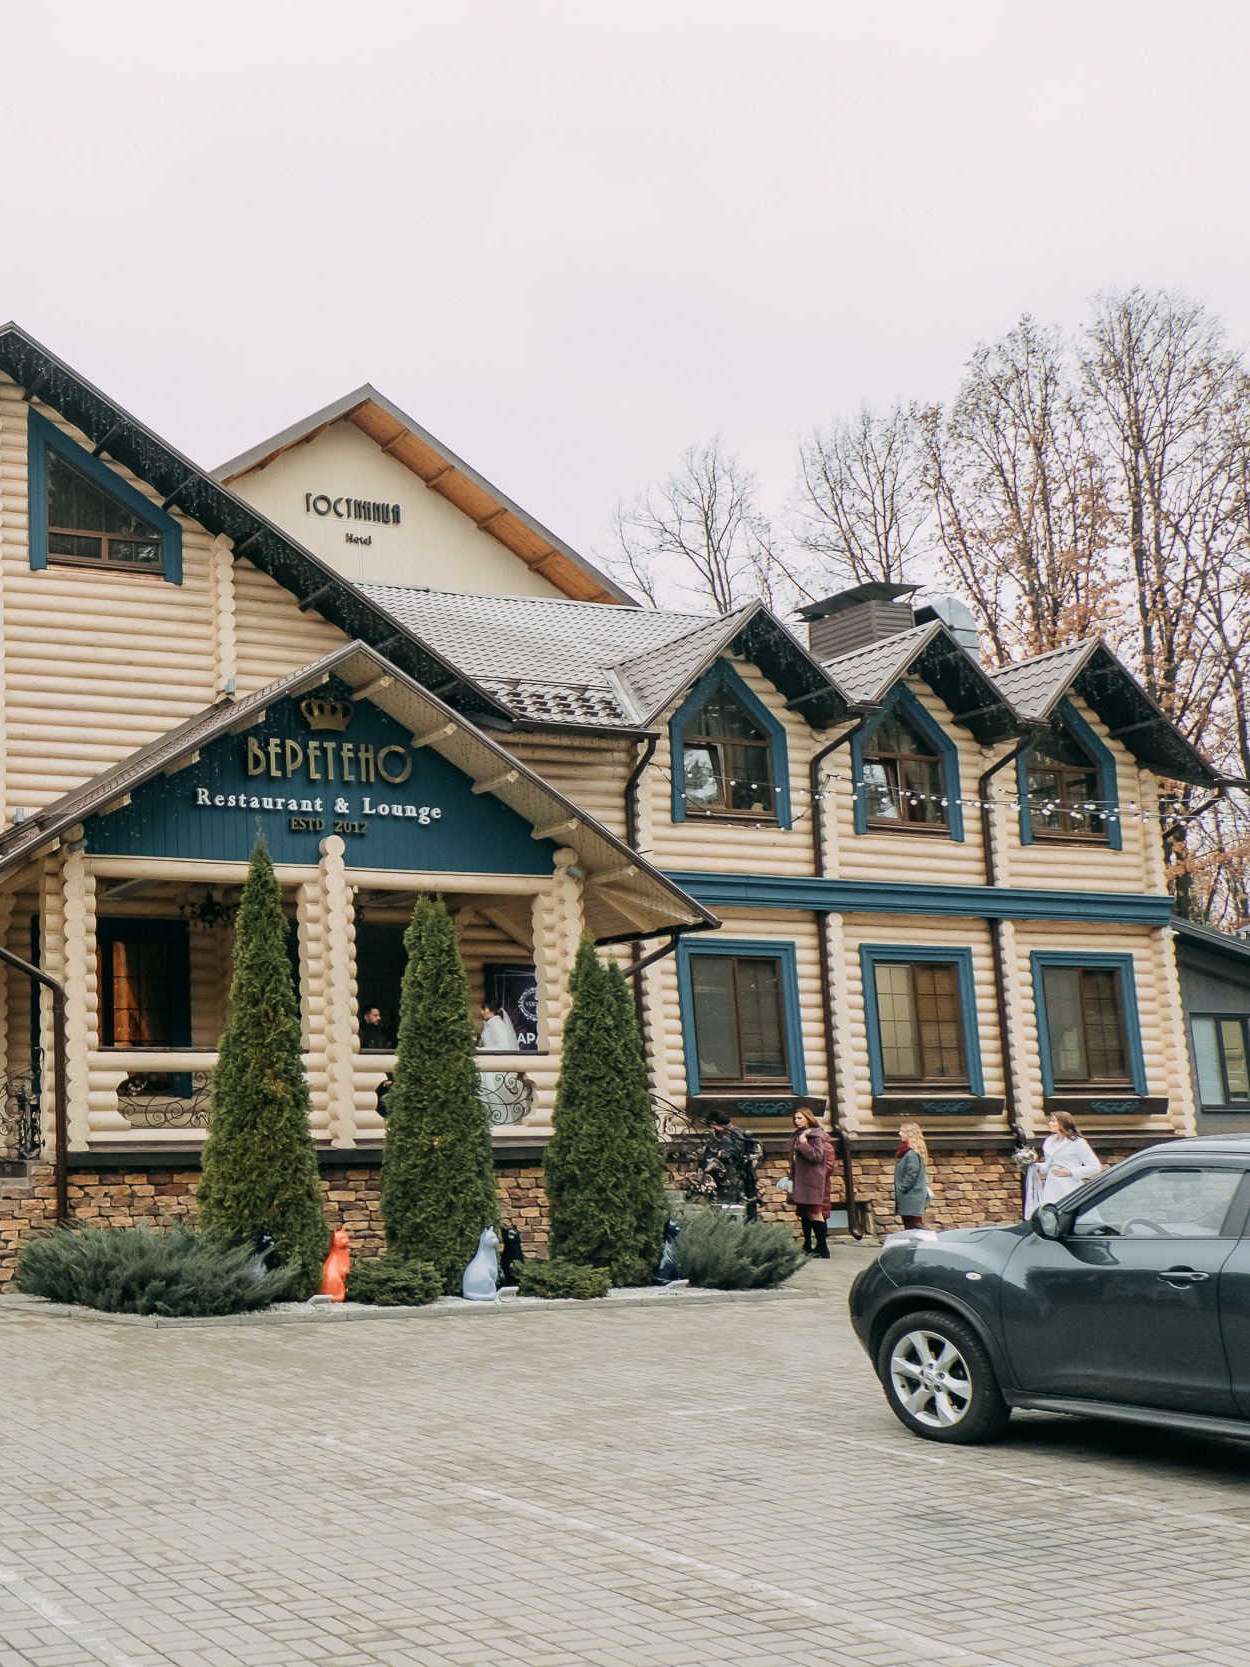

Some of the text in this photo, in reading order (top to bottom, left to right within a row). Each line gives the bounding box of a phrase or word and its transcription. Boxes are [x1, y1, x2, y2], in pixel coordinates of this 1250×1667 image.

[305, 492, 401, 525] ГОСТИНИЦА
[345, 532, 373, 546] Hotel
[247, 736, 413, 784] ВЕРЕТЕНО
[196, 787, 442, 825] Restaurant & Lounge
[290, 817, 368, 834] ESTD 2012
